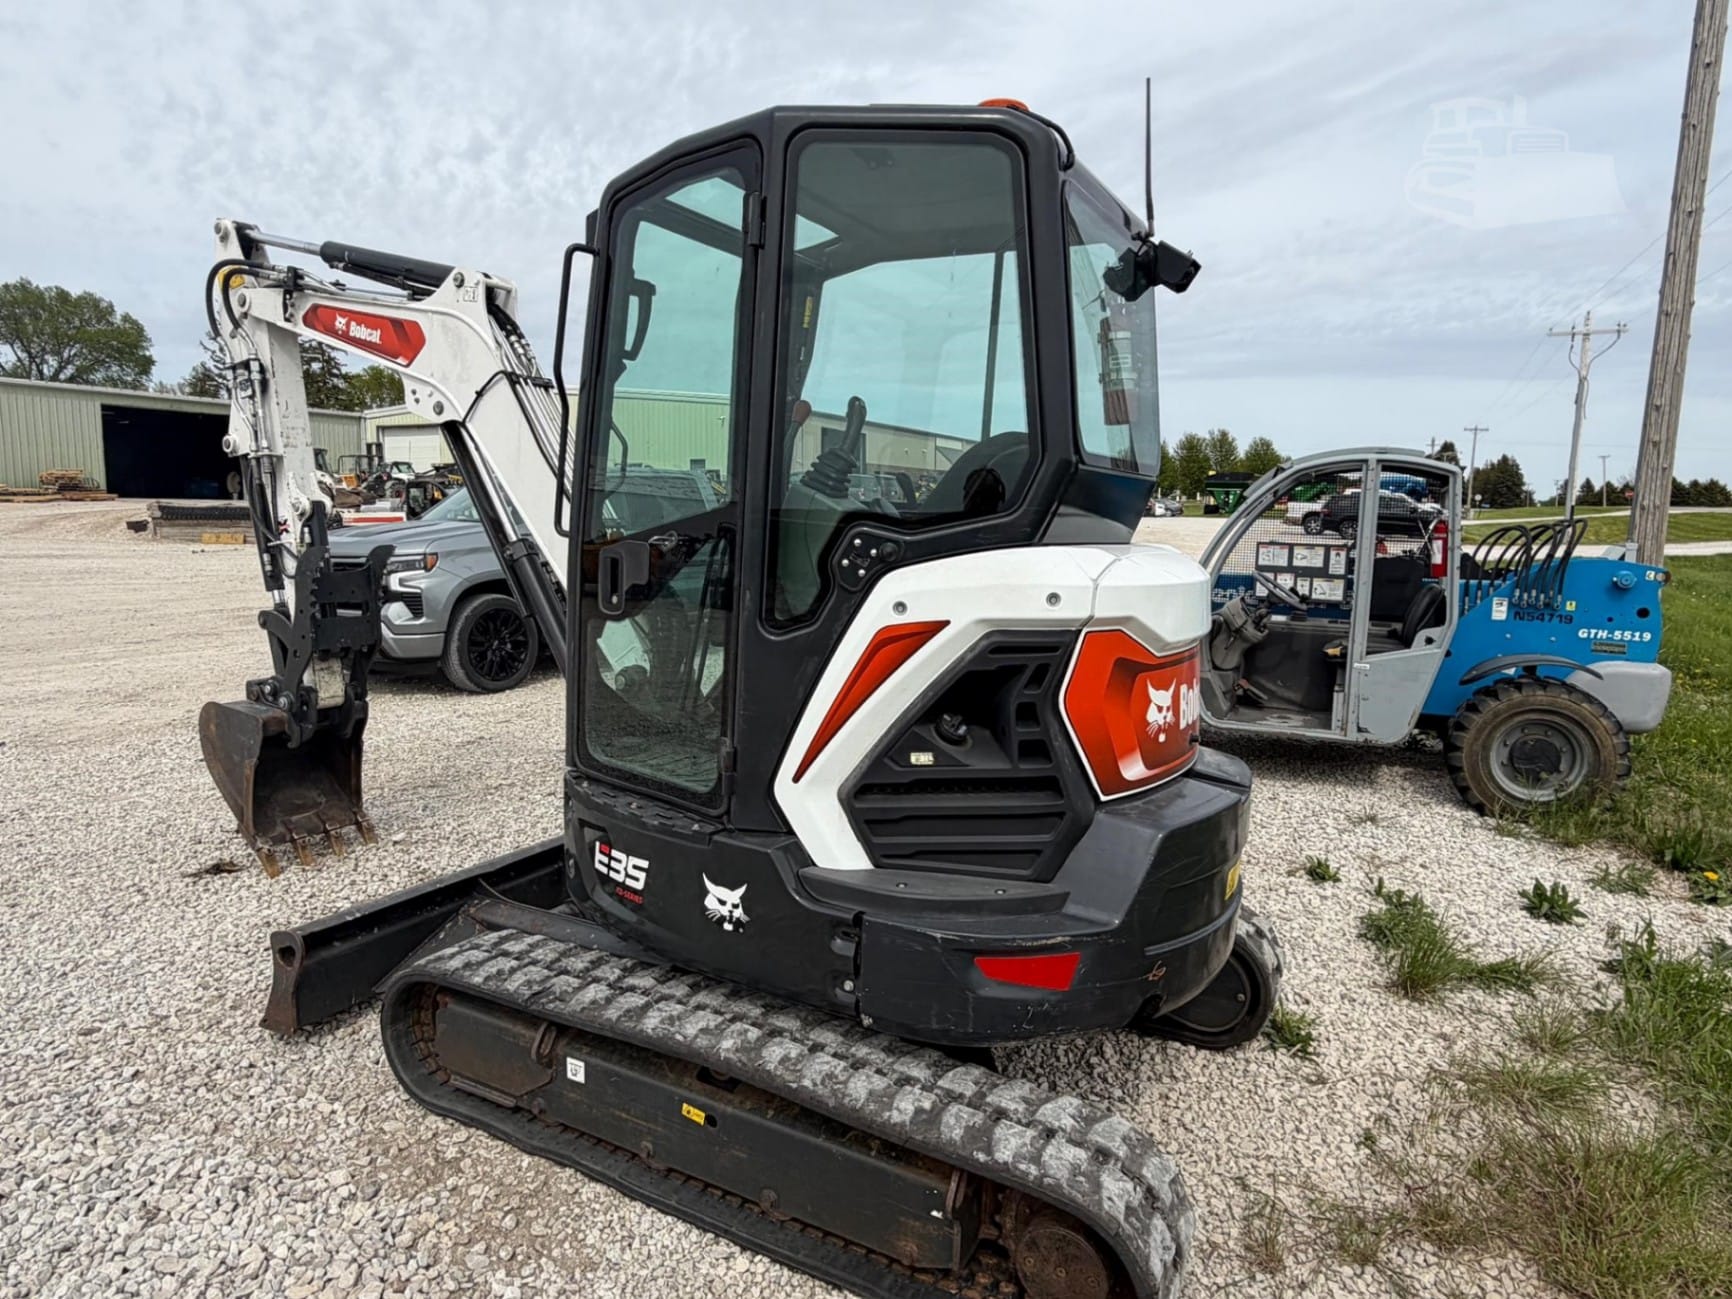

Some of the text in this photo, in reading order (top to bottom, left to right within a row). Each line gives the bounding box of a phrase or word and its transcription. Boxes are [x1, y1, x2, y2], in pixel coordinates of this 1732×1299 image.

[349, 320, 381, 343] Bobcat
[1513, 611, 1574, 625] N54719
[1578, 628, 1652, 642] GTH-5519
[1180, 678, 1200, 730] Bob
[594, 840, 650, 890] E35
